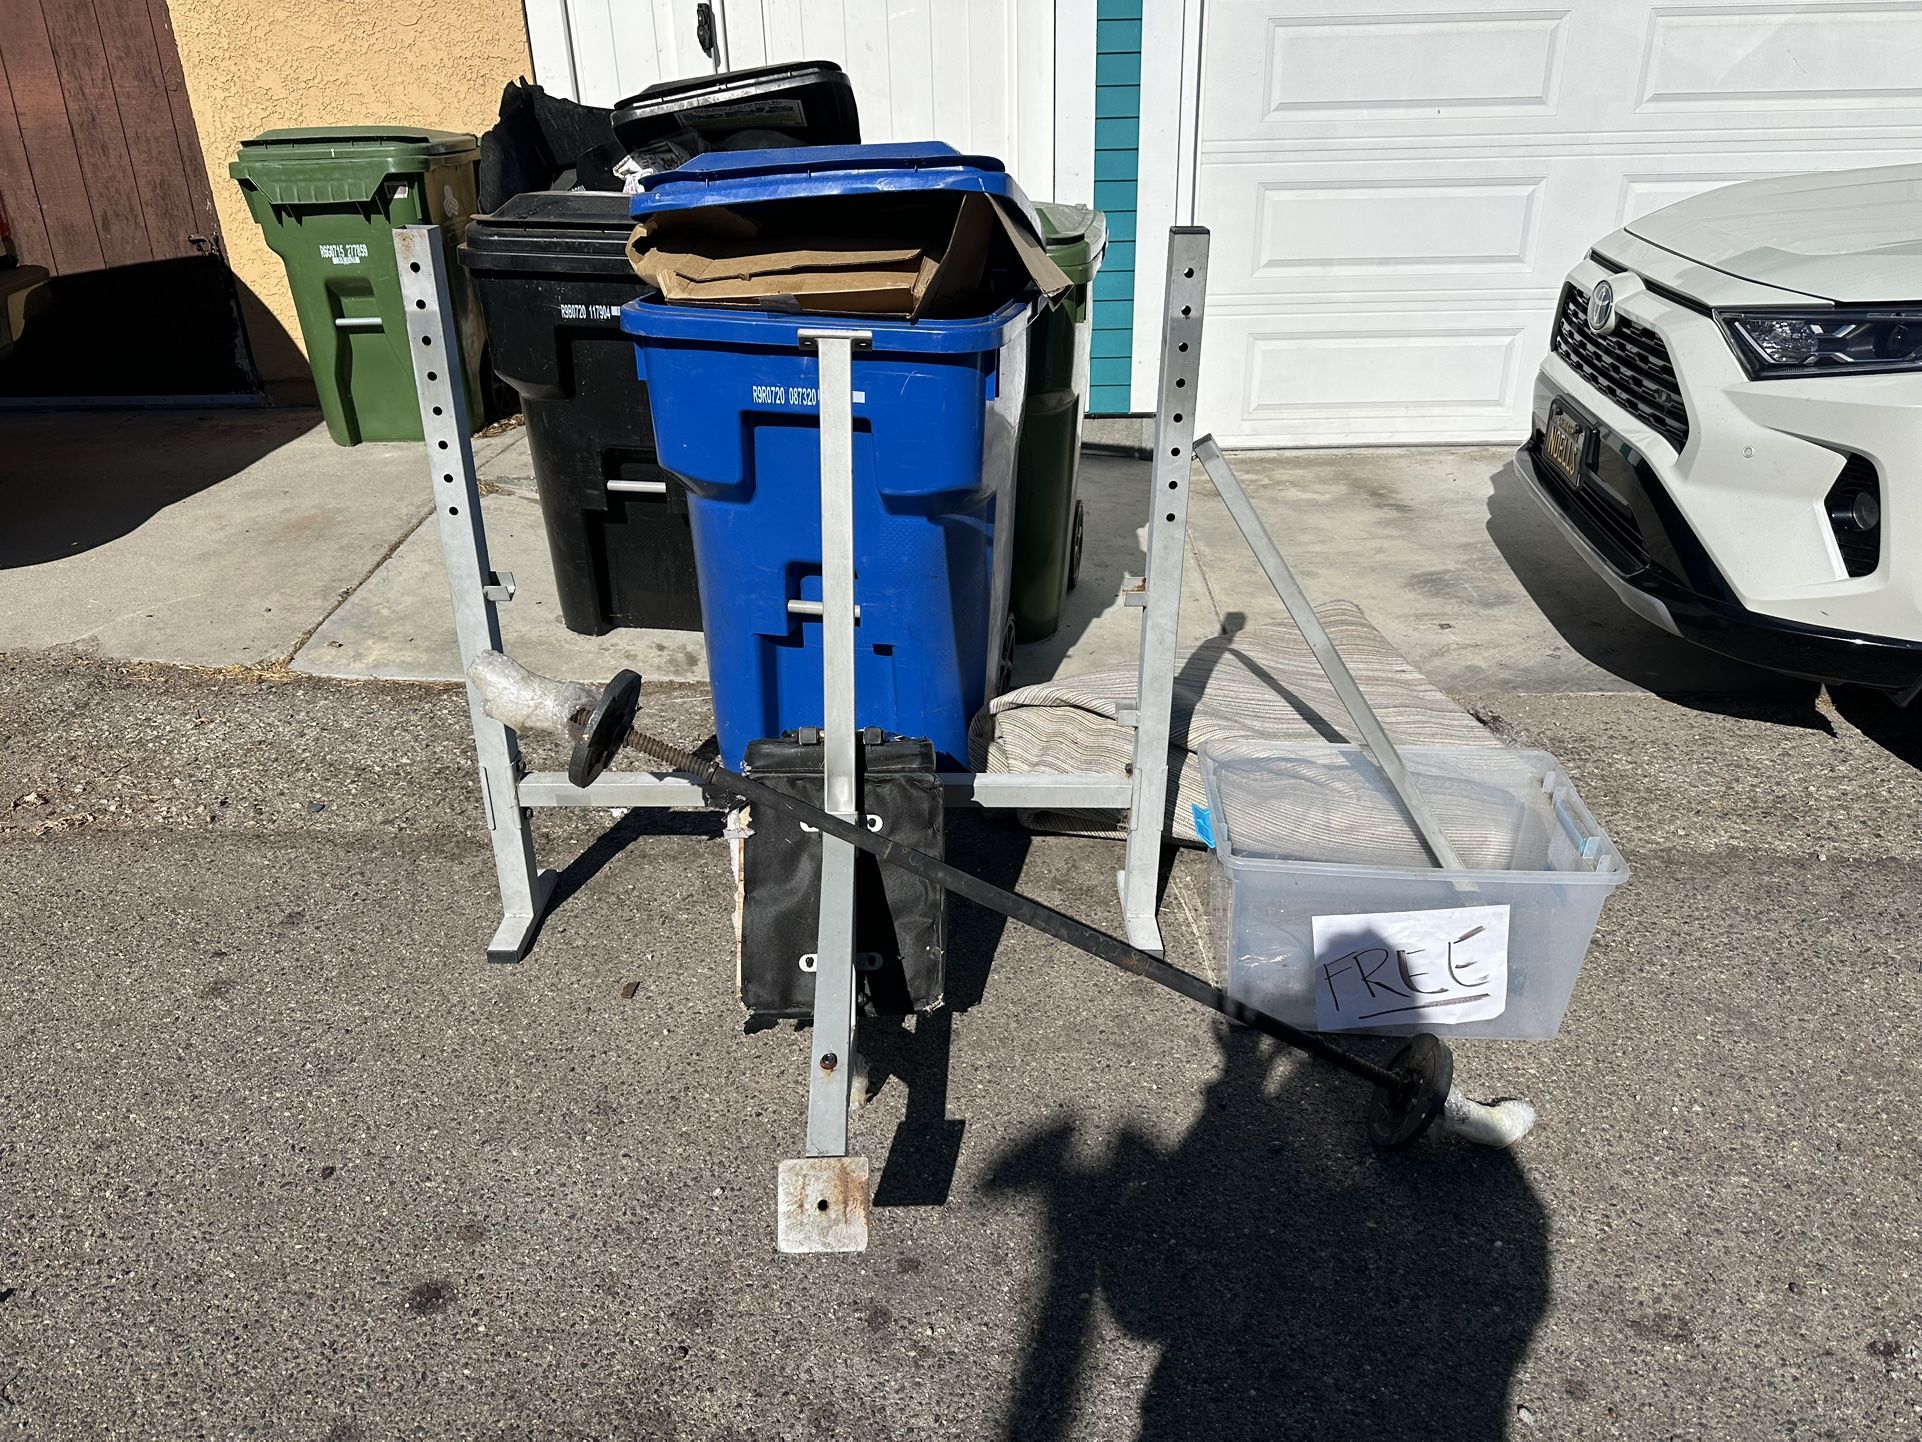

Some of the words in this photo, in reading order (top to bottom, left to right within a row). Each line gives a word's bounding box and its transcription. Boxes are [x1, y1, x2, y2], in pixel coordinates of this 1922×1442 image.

[753, 385, 785, 404] R9R0720
[789, 388, 817, 405] 087320
[1324, 926, 1490, 1011] FREE
